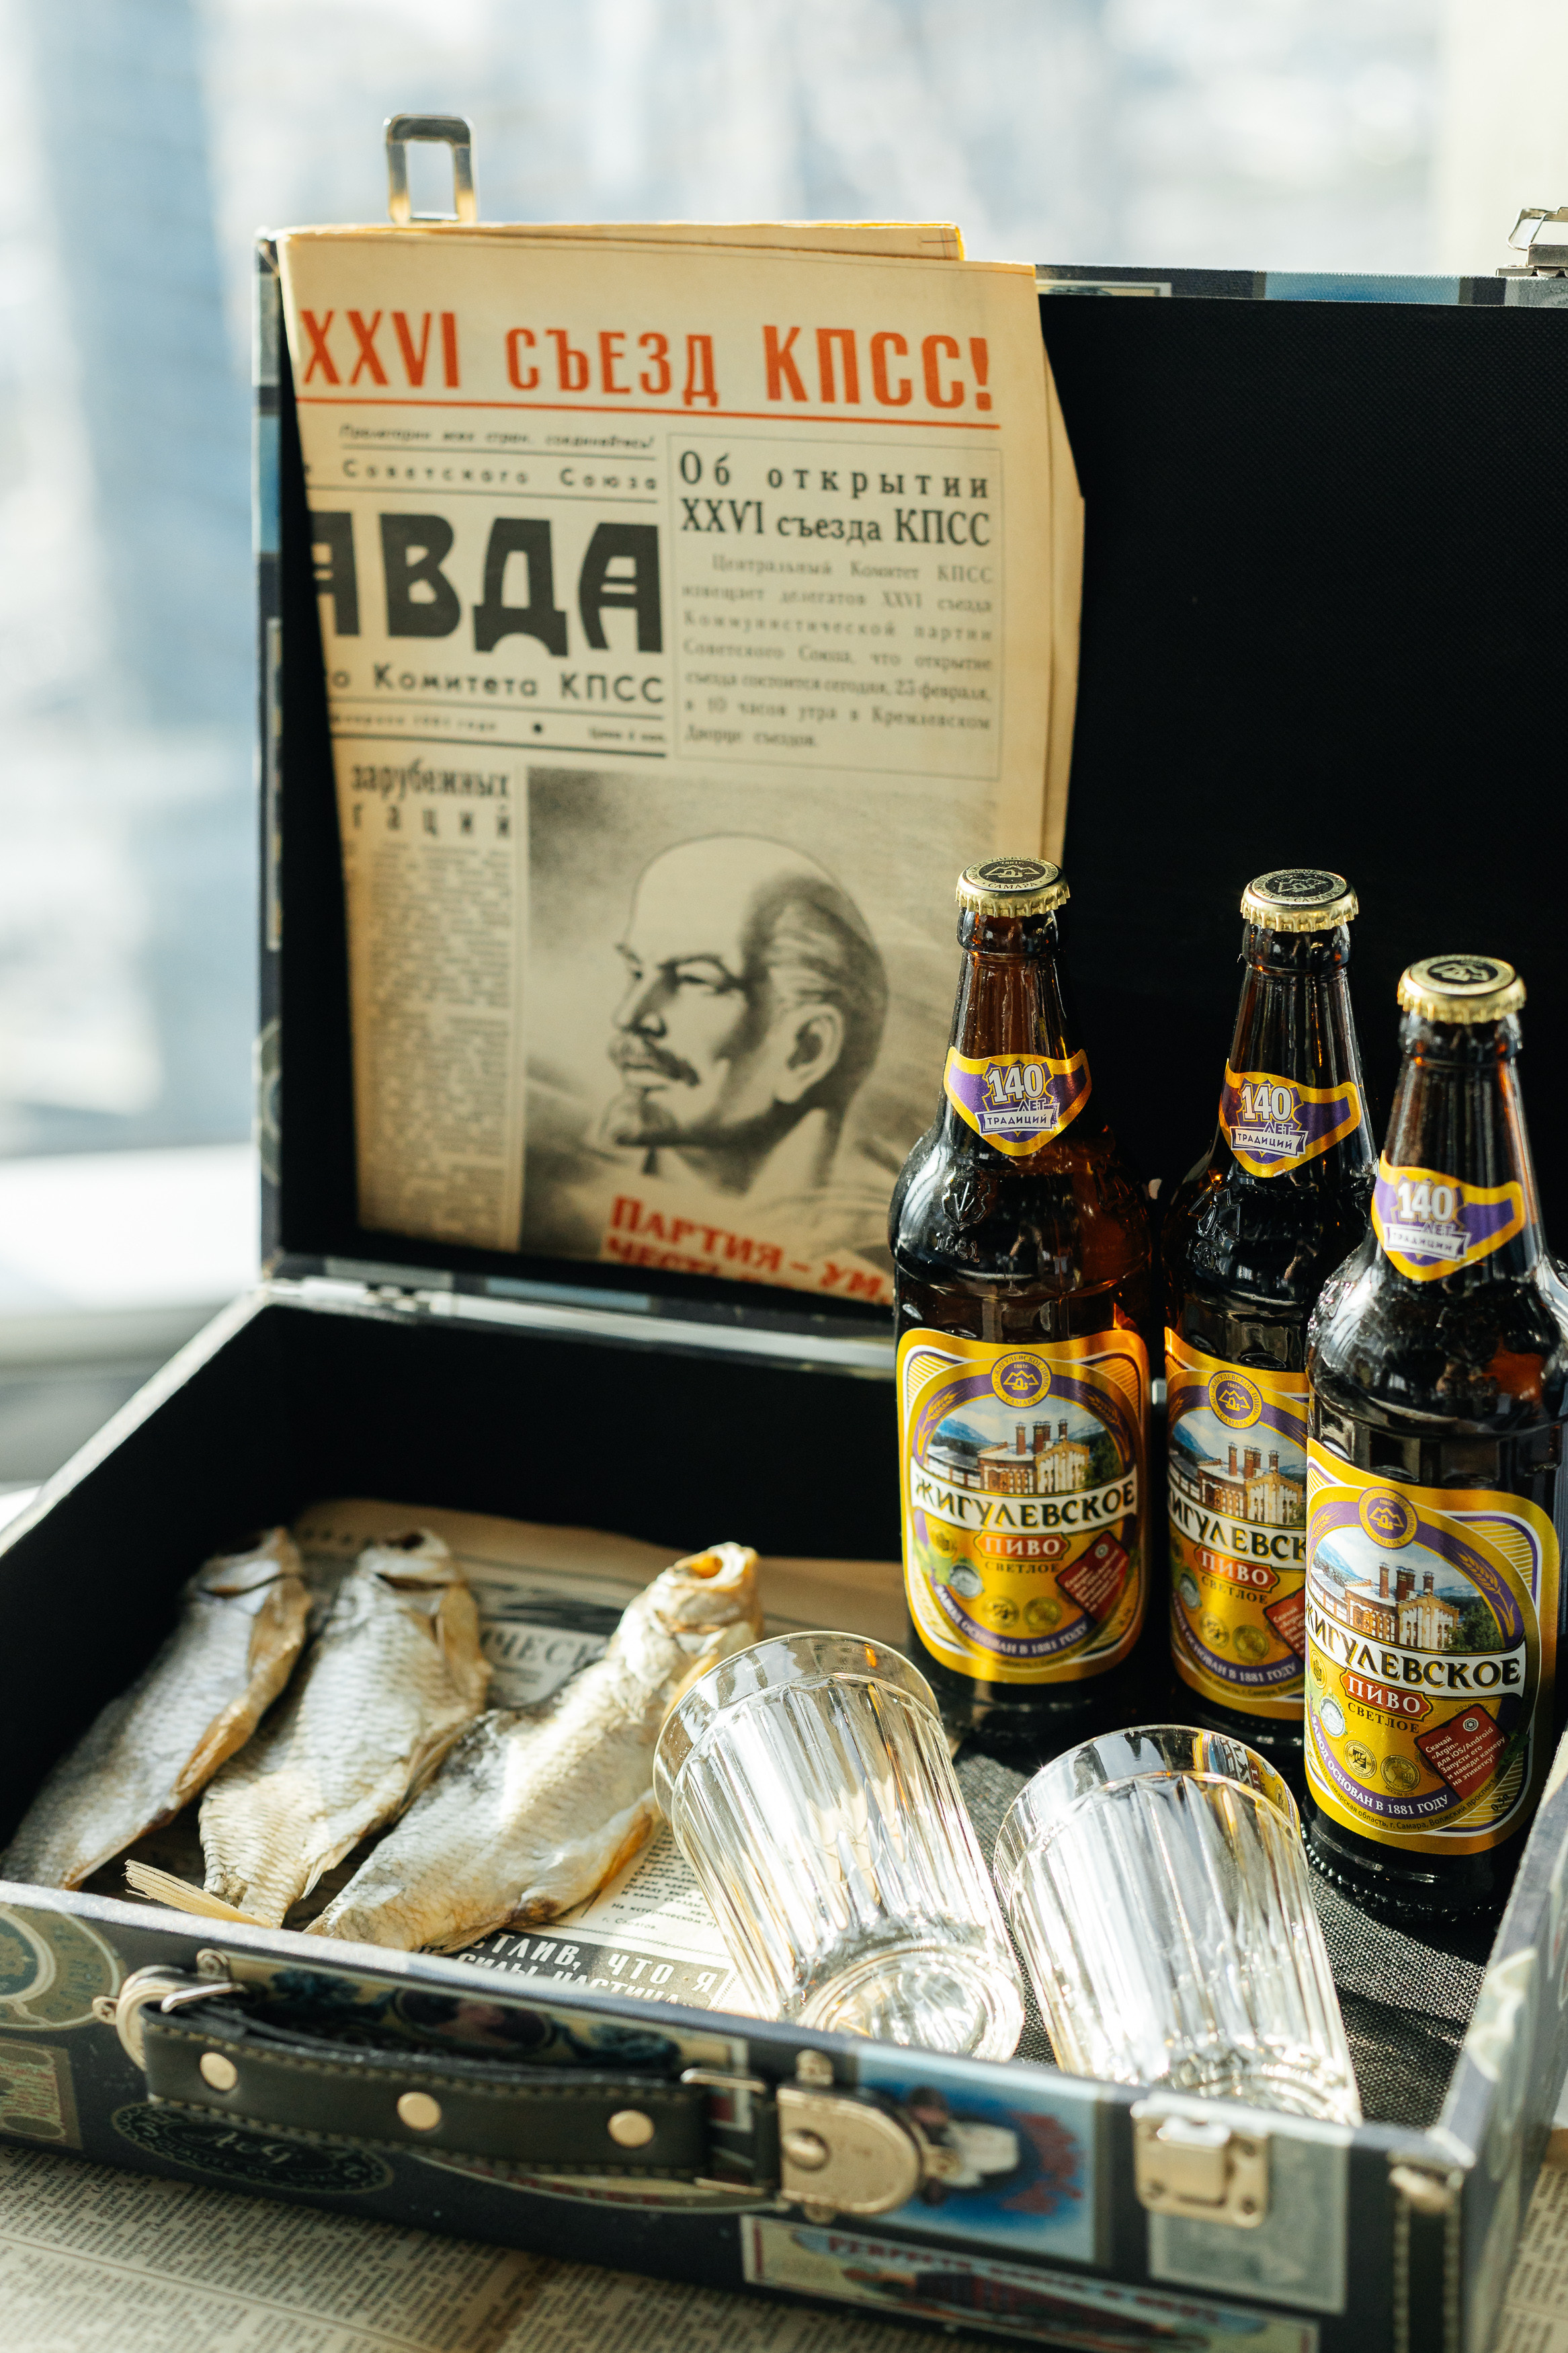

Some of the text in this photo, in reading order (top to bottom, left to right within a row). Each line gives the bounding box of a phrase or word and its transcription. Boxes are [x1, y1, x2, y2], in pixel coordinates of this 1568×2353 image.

[300, 310, 993, 411] XXVI СЪЕЗД КПСС!
[343, 460, 657, 491] Советского Союза
[679, 451, 989, 500] Об открытии
[680, 498, 991, 547] XXVI съезда КПСС
[712, 554, 993, 584] Центральный Комитет КПСС
[780, 591, 865, 605] делегатов
[882, 591, 922, 609] XXVI
[684, 610, 993, 642] Коммунистической партии
[684, 639, 784, 659] Советского
[870, 652, 901, 666] что
[374, 663, 539, 696] Комитета
[562, 673, 664, 703] КПСС
[872, 707, 991, 731] Кремлевском
[352, 758, 510, 800] зарубежных
[1294, 891, 1339, 902] САМАРА
[988, 1064, 1044, 1103] 140
[1018, 1099, 1045, 1112] ЛЕТ
[1241, 1085, 1292, 1121] 140
[987, 1114, 1047, 1125] ТРАДИЦИЙ
[1264, 1121, 1293, 1135] ЛЕТ
[1237, 1133, 1292, 1150] ТРАДИЦИЙ
[1398, 1181, 1454, 1222] 140
[611, 1194, 783, 1273] ПАРТИЯ
[1005, 1396, 1038, 1406] САМАРА
[1220, 1413, 1249, 1427] САМАРА
[915, 1474, 1135, 1528] ЖИГУЛЕВСКОЕ
[985, 1536, 1061, 1556] ПИВО
[985, 1561, 1061, 1574] СВЕТЛОЕ
[1202, 1550, 1269, 1586] ПИВО
[1202, 1575, 1269, 1605] СВЕТЛОЕ
[1348, 1675, 1421, 1714] ПИВО
[1348, 1702, 1419, 1734] СВЕТЛОЕ
[1426, 1735, 1452, 1753] Скачай
[1432, 1743, 1458, 1760] «Argin»
[1437, 1757, 1451, 1768] для
[1452, 1726, 1493, 1759] iOS/Android
[1441, 1745, 1483, 1774] Запусти его
[1454, 1757, 1480, 1776] наведи
[1481, 1737, 1505, 1759] камеру
[1311, 1716, 1329, 1761] ЗАВОД
[1327, 1760, 1373, 1807] ОСНОВАН
[1376, 1800, 1383, 1810] В
[1388, 1804, 1415, 1814] 1881
[1417, 1794, 1448, 1813] ГОДУ
[1452, 1754, 1495, 1786] на этикетку!
[1328, 1779, 1357, 1812] Самарская
[1358, 1810, 1389, 1828] область,
[1398, 1821, 1429, 1831] Самара,
[1429, 1804, 1467, 1827] Волжский
[1385, 1786, 1403, 1797] МОСКВА
[1490, 1792, 1510, 1812] 0,5л
[608, 1953, 675, 1985] ЧТО
[691, 1971, 718, 1993] Я
